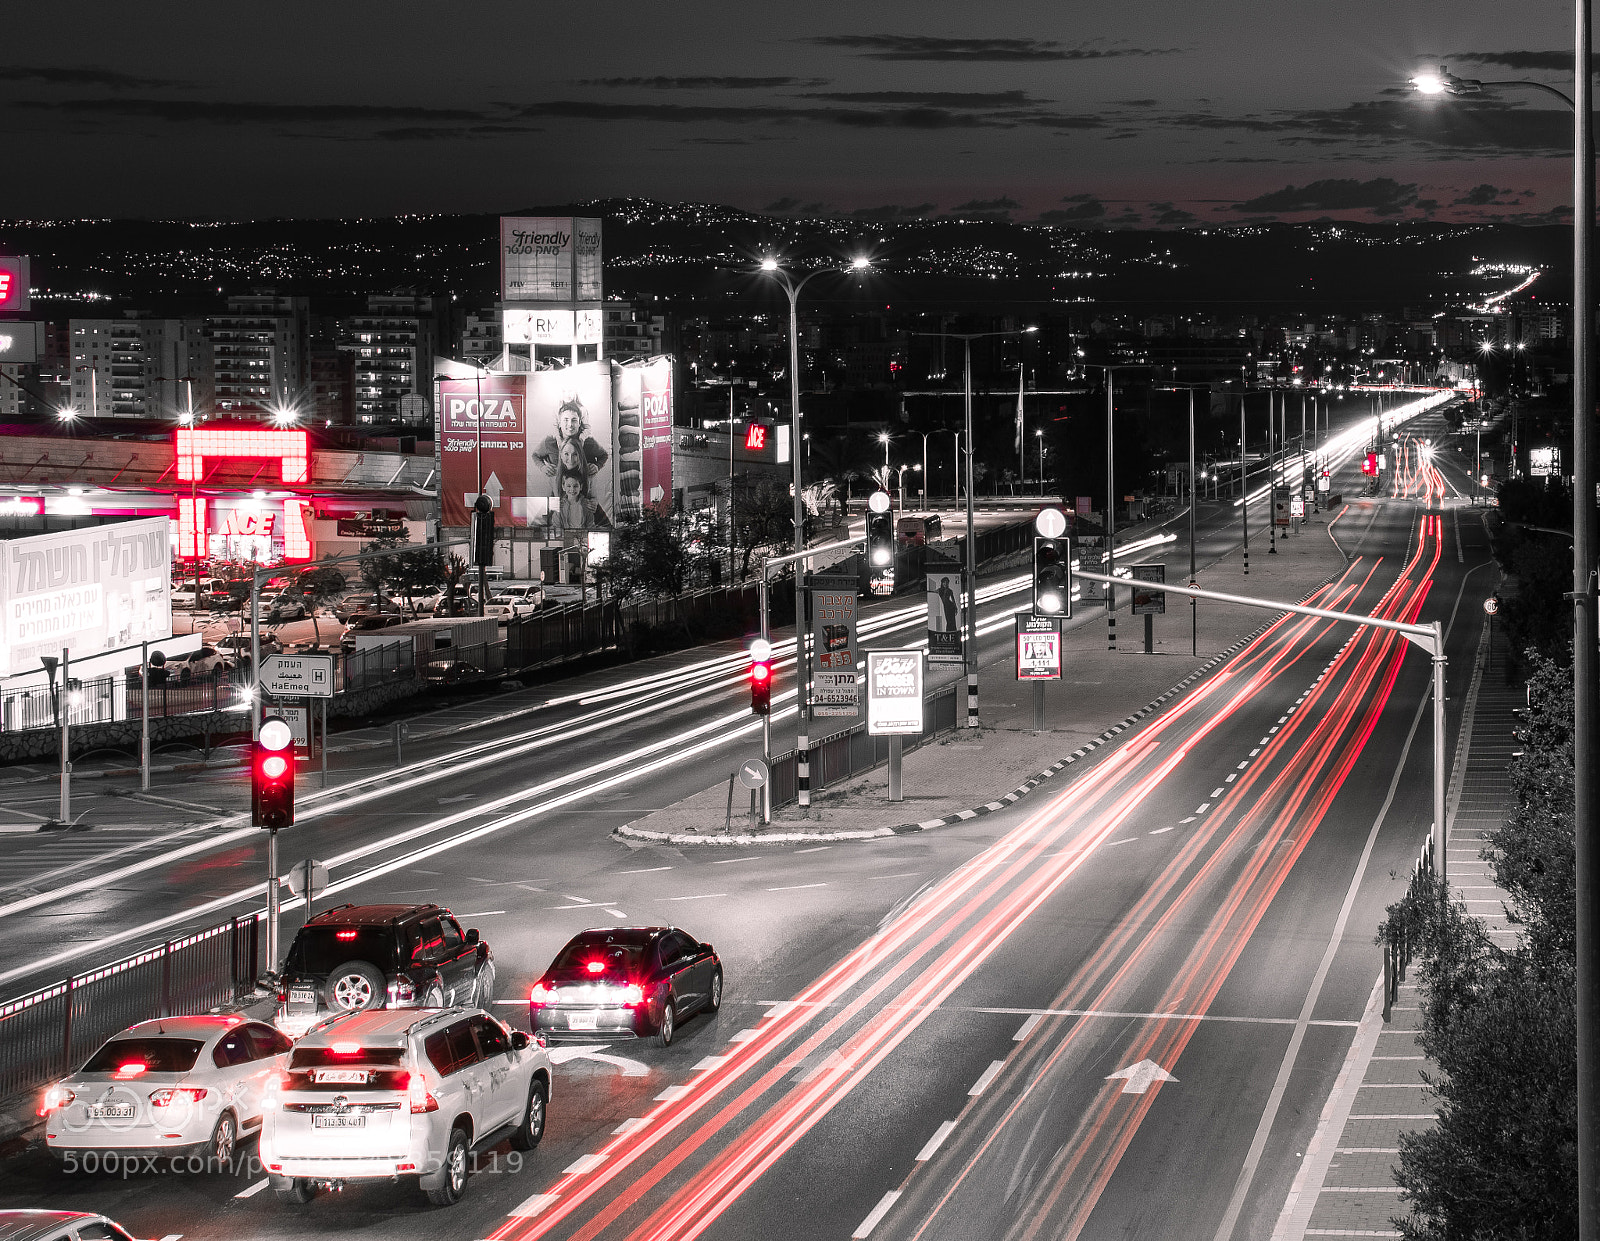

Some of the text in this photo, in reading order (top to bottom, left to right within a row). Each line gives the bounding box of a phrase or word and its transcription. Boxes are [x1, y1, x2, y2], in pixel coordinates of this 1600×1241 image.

[512, 230, 571, 247] friendly
[505, 245, 560, 257] עמק סנטר
[450, 399, 517, 420] POZA
[643, 395, 669, 417] POZA
[746, 423, 765, 448] ACE
[447, 438, 477, 449] friendly
[509, 441, 524, 450] כאן
[218, 508, 276, 535] ACE
[12, 531, 165, 593] טרקלין חשמל
[15, 588, 98, 619] עם כאלה מחירים
[818, 595, 853, 605] מצבר
[819, 606, 852, 619] לרכב
[19, 617, 59, 639] מתחרים
[278, 661, 302, 669] העמק
[314, 672, 323, 681] H
[834, 675, 855, 686] מתן
[271, 682, 309, 692] HaEmeq
[877, 686, 916, 696] IN TOWN
[815, 694, 858, 703] 04-6523946
